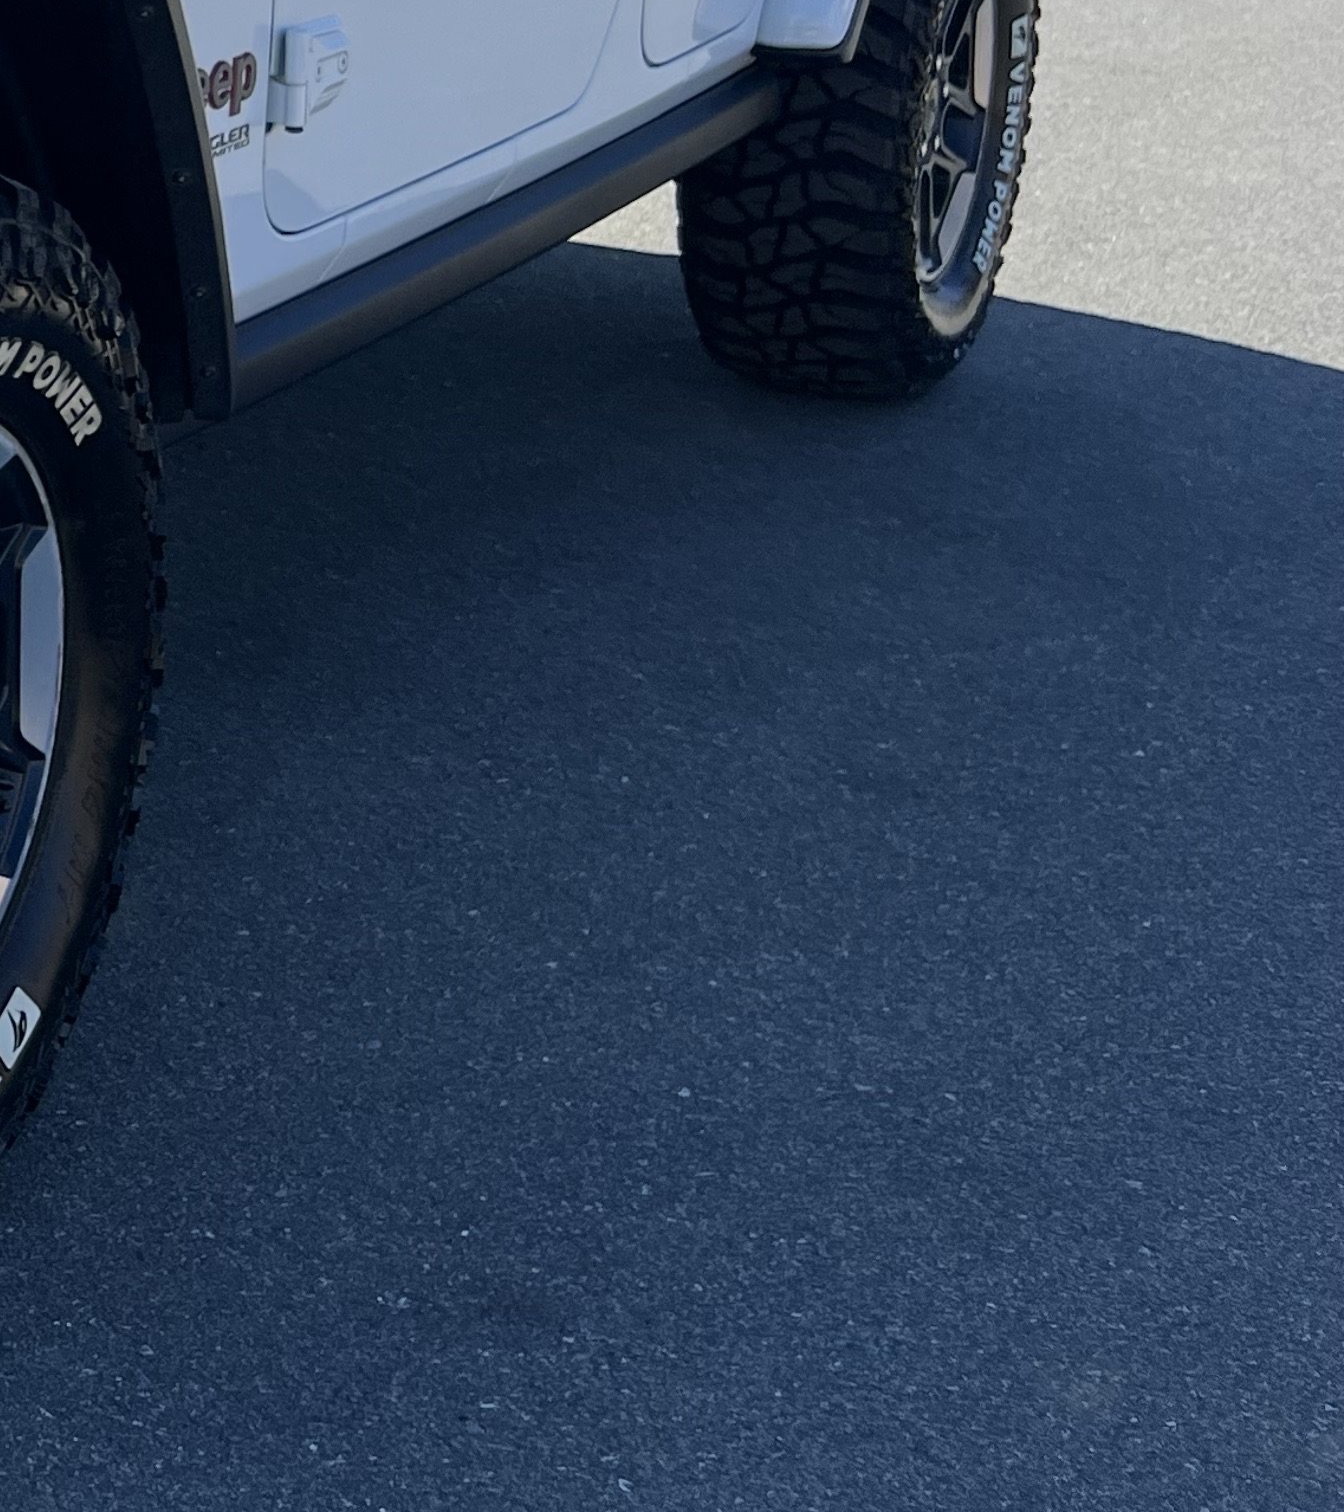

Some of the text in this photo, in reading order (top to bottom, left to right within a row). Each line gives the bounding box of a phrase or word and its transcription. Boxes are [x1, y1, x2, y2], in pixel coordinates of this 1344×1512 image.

[197, 51, 257, 117] eep
[210, 123, 250, 149] GLER
[212, 139, 250, 158] MITED
[973, 63, 1025, 274] VENOM POWER
[13, 340, 103, 446] POWER
